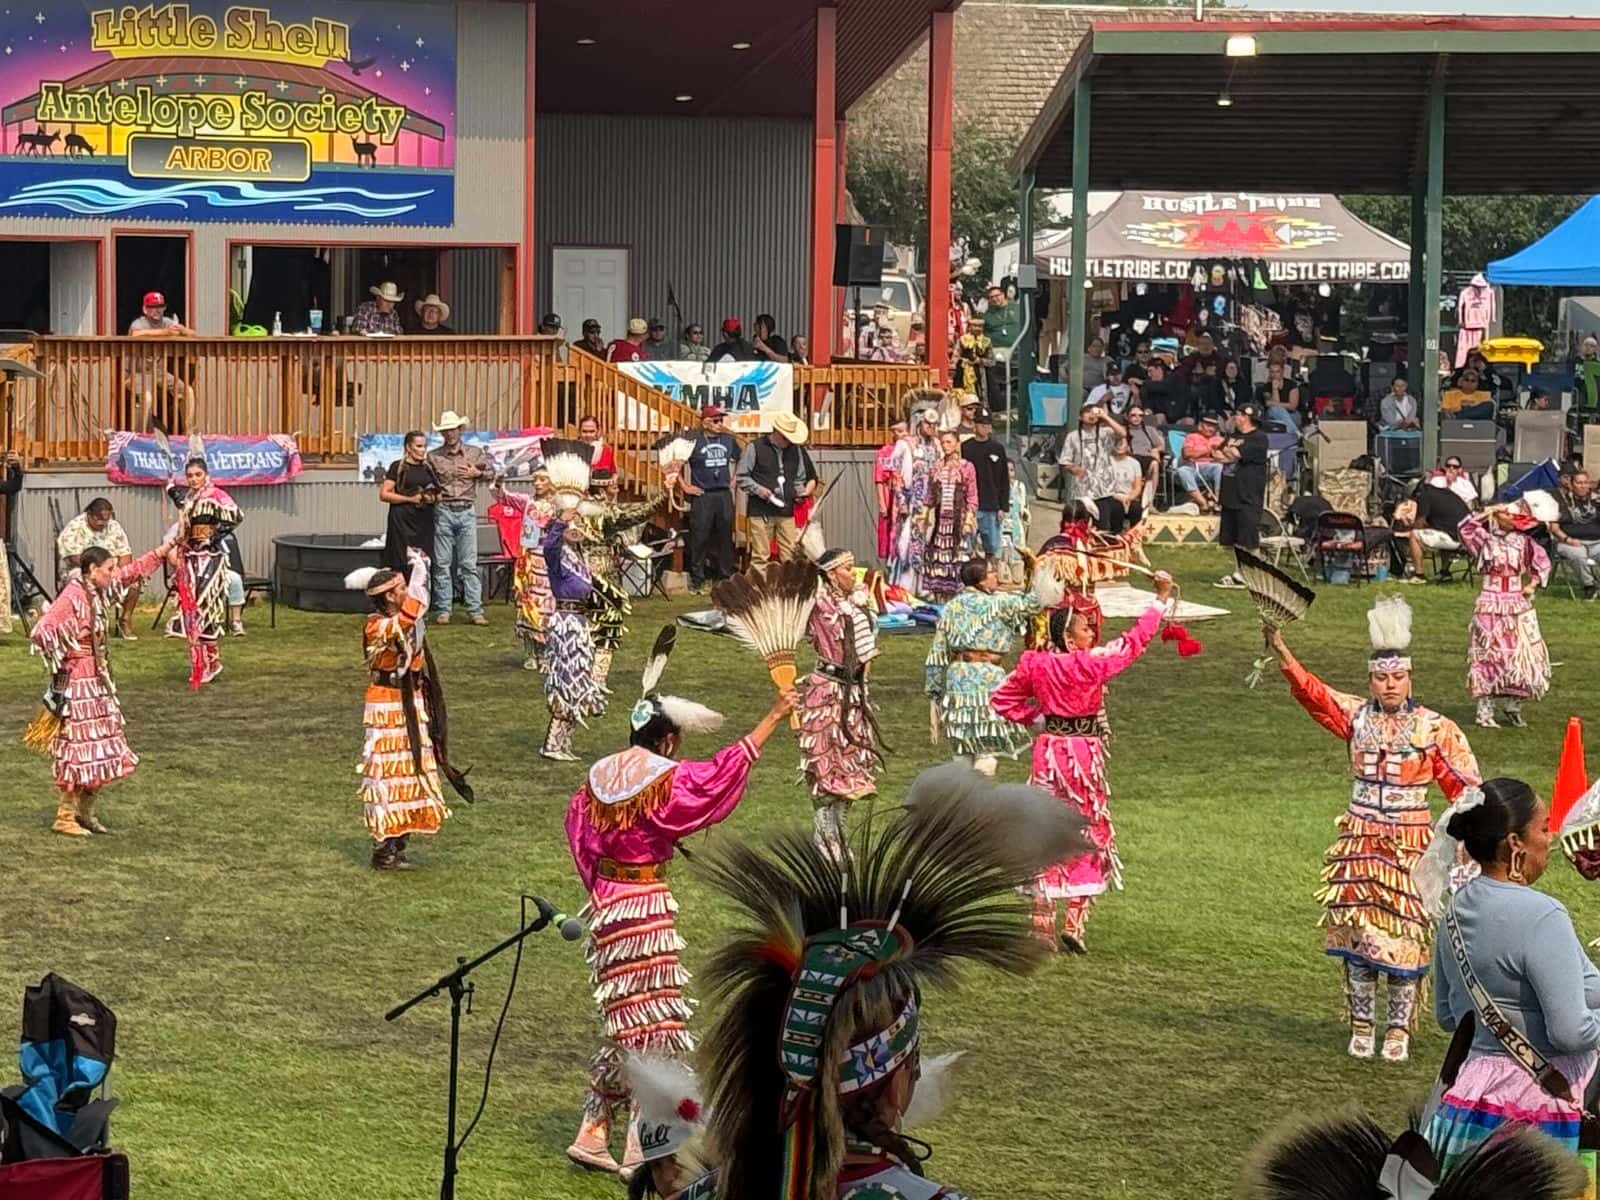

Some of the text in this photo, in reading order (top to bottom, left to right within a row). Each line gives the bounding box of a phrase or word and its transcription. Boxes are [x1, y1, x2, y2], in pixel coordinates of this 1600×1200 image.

[92, 4, 351, 60] Little Shell
[37, 81, 405, 144] Antelope Society
[165, 146, 272, 173] ARBOR
[1050, 257, 1191, 280] HUTLETRIBE.CO
[210, 450, 283, 470] VETERANS
